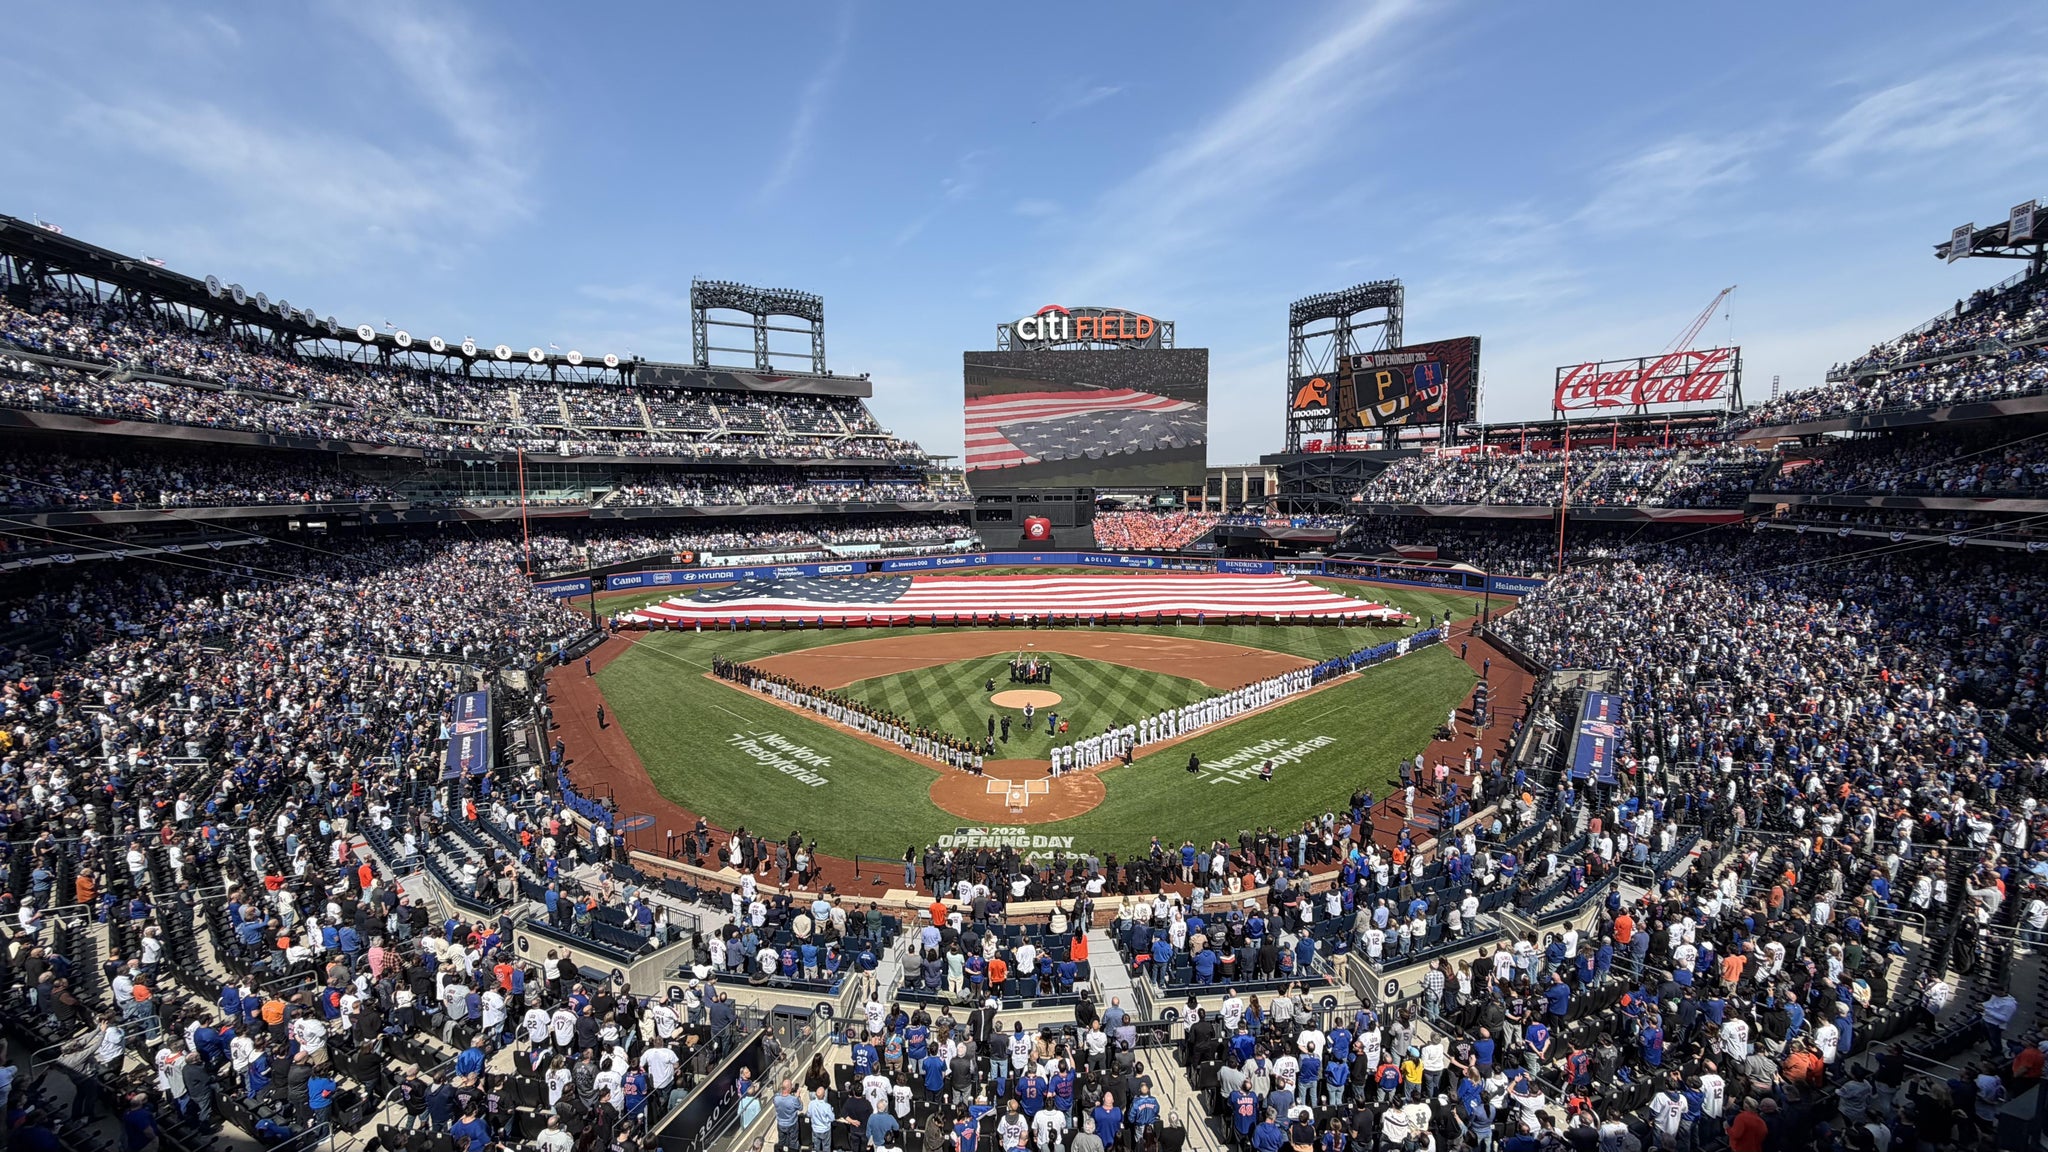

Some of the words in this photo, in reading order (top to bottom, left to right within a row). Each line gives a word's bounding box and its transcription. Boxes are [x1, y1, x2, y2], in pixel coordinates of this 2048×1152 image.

[1017, 310, 1068, 340] citi
[1077, 315, 1154, 340] FIELD
[1375, 353, 1404, 367] OPENING
[1404, 353, 1415, 365] DAY
[1376, 371, 1392, 400] P
[1293, 408, 1331, 418] moomoo
[818, 565, 853, 573] GEICO
[612, 576, 642, 586] Canon
[698, 572, 734, 580] HYUNDAI
[1495, 581, 1535, 592] Heineken
[731, 739, 829, 787] Presbyterian
[991, 827, 1026, 836] 2026
[937, 834, 1031, 849] OPENING
[1032, 835, 1075, 849] DAY
[1028, 850, 1091, 860] Adbe
[868, 1011, 879, 1021] 22
[1738, 1032, 1746, 1042] 12
[1368, 1043, 1380, 1053] 22
[856, 1056, 868, 1067] 22
[1282, 1068, 1295, 1078] 22
[871, 1088, 878, 1099] 4
[1713, 1089, 1722, 1099] 12
[1670, 1107, 1677, 1118] 5
